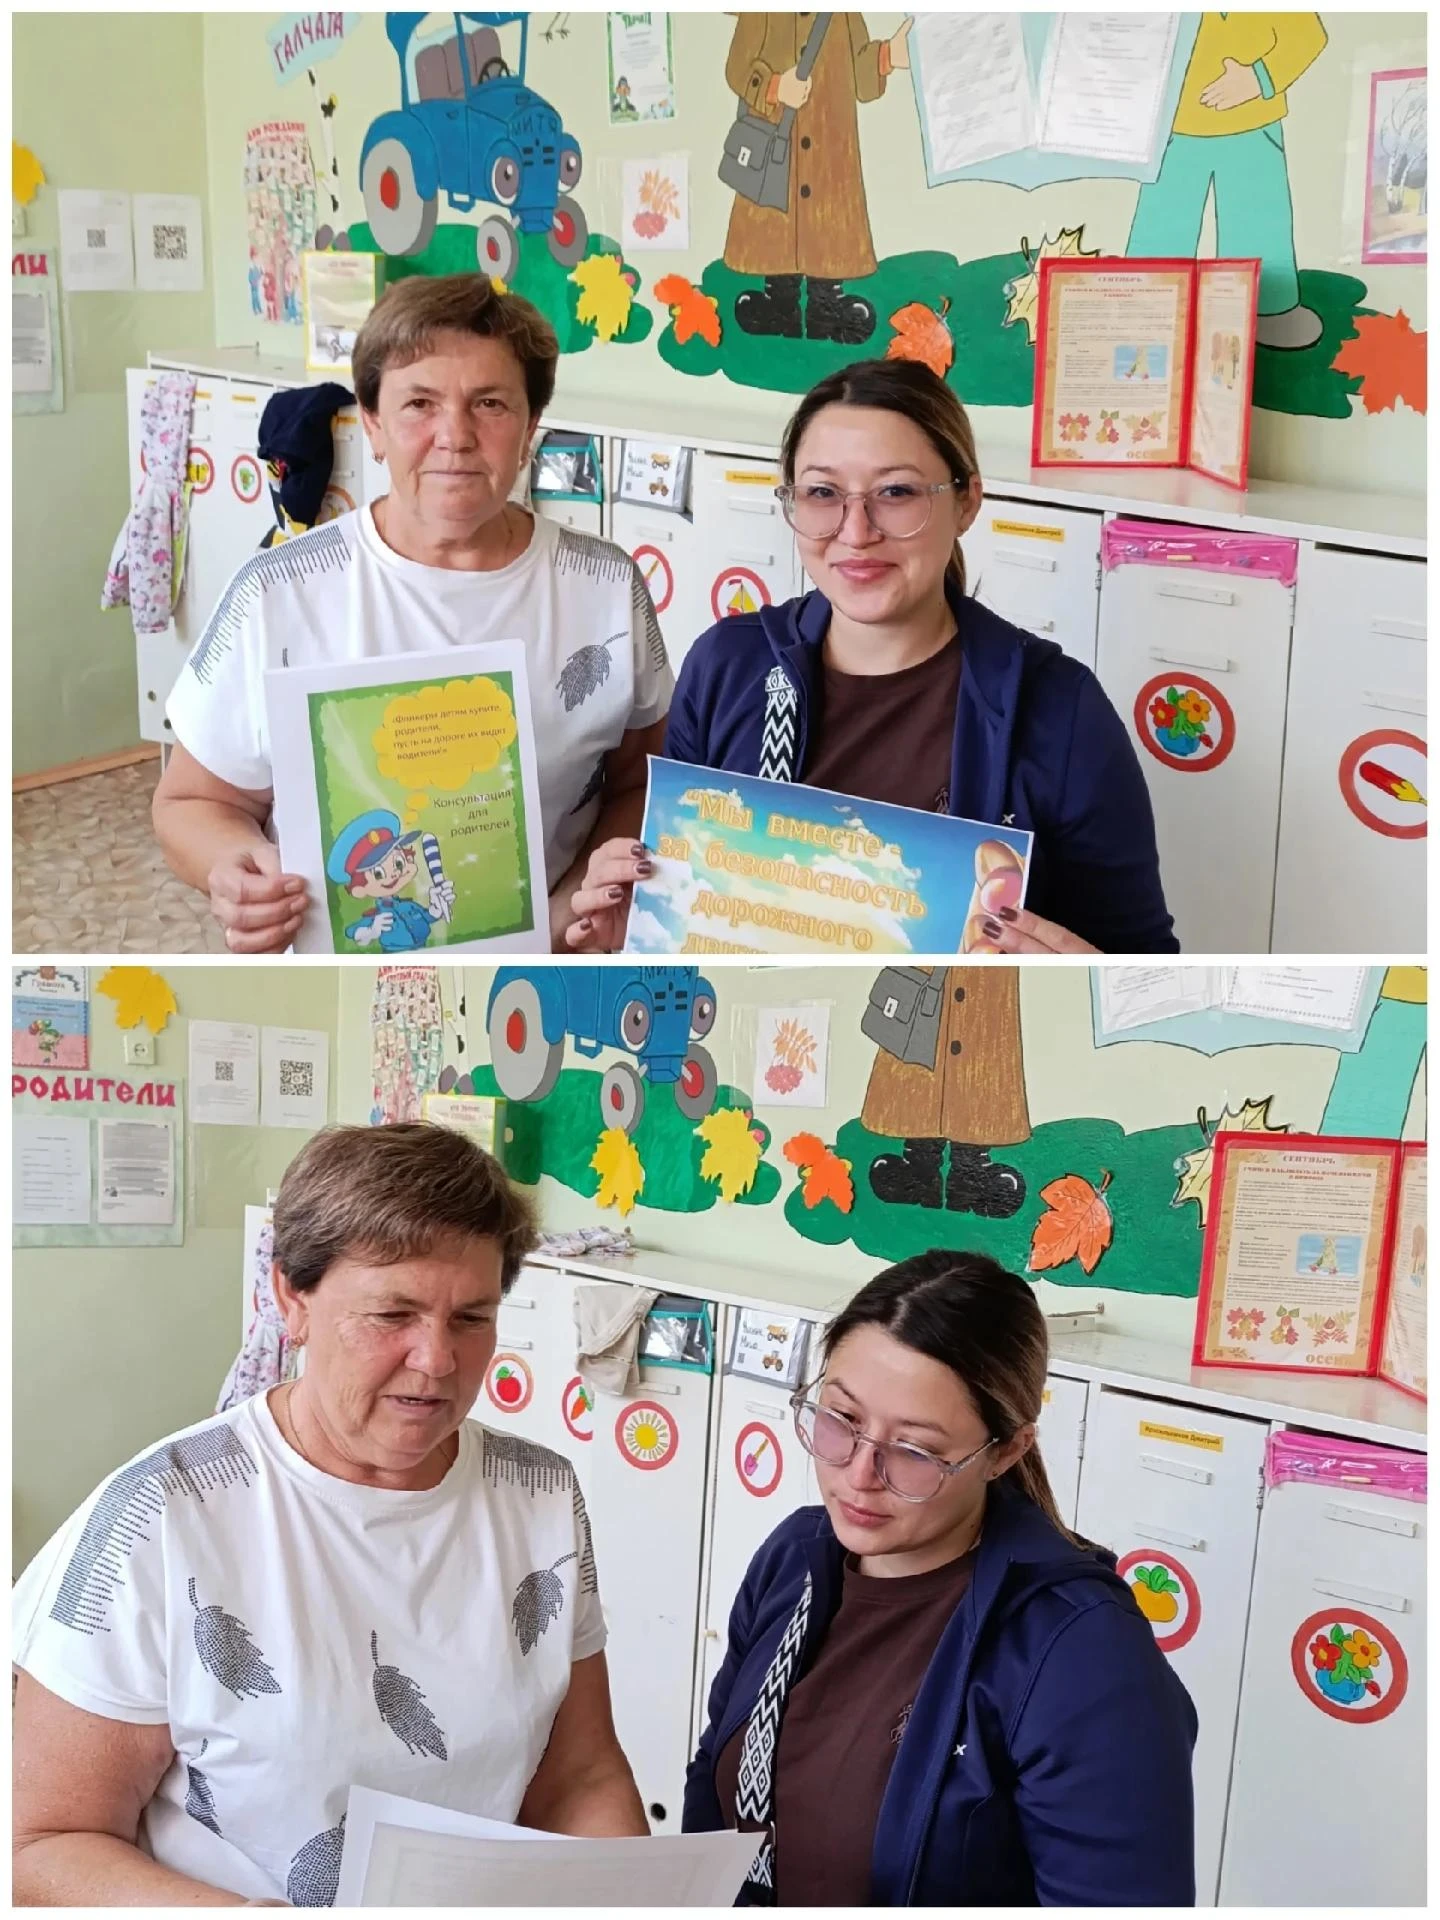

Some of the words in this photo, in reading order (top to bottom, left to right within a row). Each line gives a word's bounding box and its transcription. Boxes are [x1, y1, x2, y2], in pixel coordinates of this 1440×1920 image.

[274, 11, 344, 73] ГАЛЧАТА
[433, 789, 511, 808] Консультация
[468, 808, 489, 820] для
[450, 818, 510, 838] родителей
[767, 813, 885, 858] вместе
[657, 836, 691, 862] за
[705, 840, 927, 919] безопасность
[691, 889, 874, 951] дорожного
[12, 1075, 176, 1107] РОДИТЕЛИ
